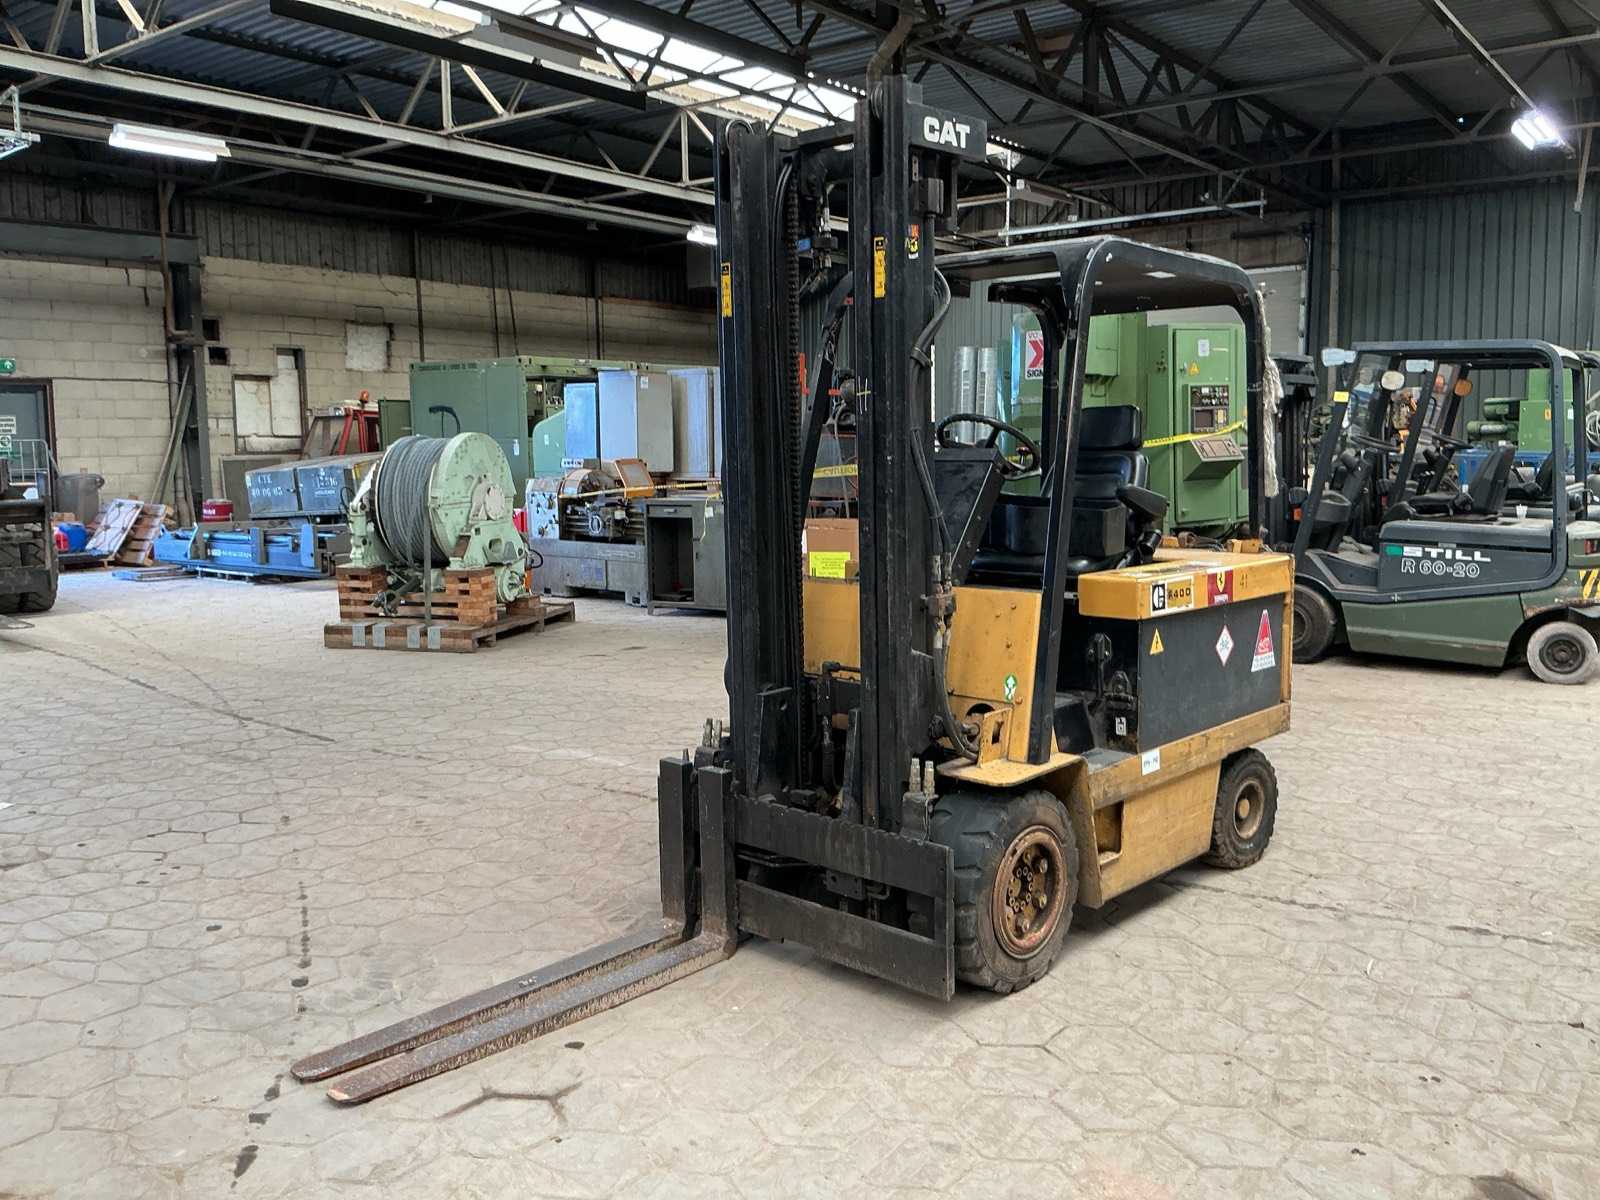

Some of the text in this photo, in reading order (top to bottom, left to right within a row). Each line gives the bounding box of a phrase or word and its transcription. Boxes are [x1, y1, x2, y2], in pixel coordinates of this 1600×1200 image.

[924, 116, 970, 149] CAT
[1403, 546, 1492, 562] STILL
[1401, 558, 1480, 578] R 60-20
